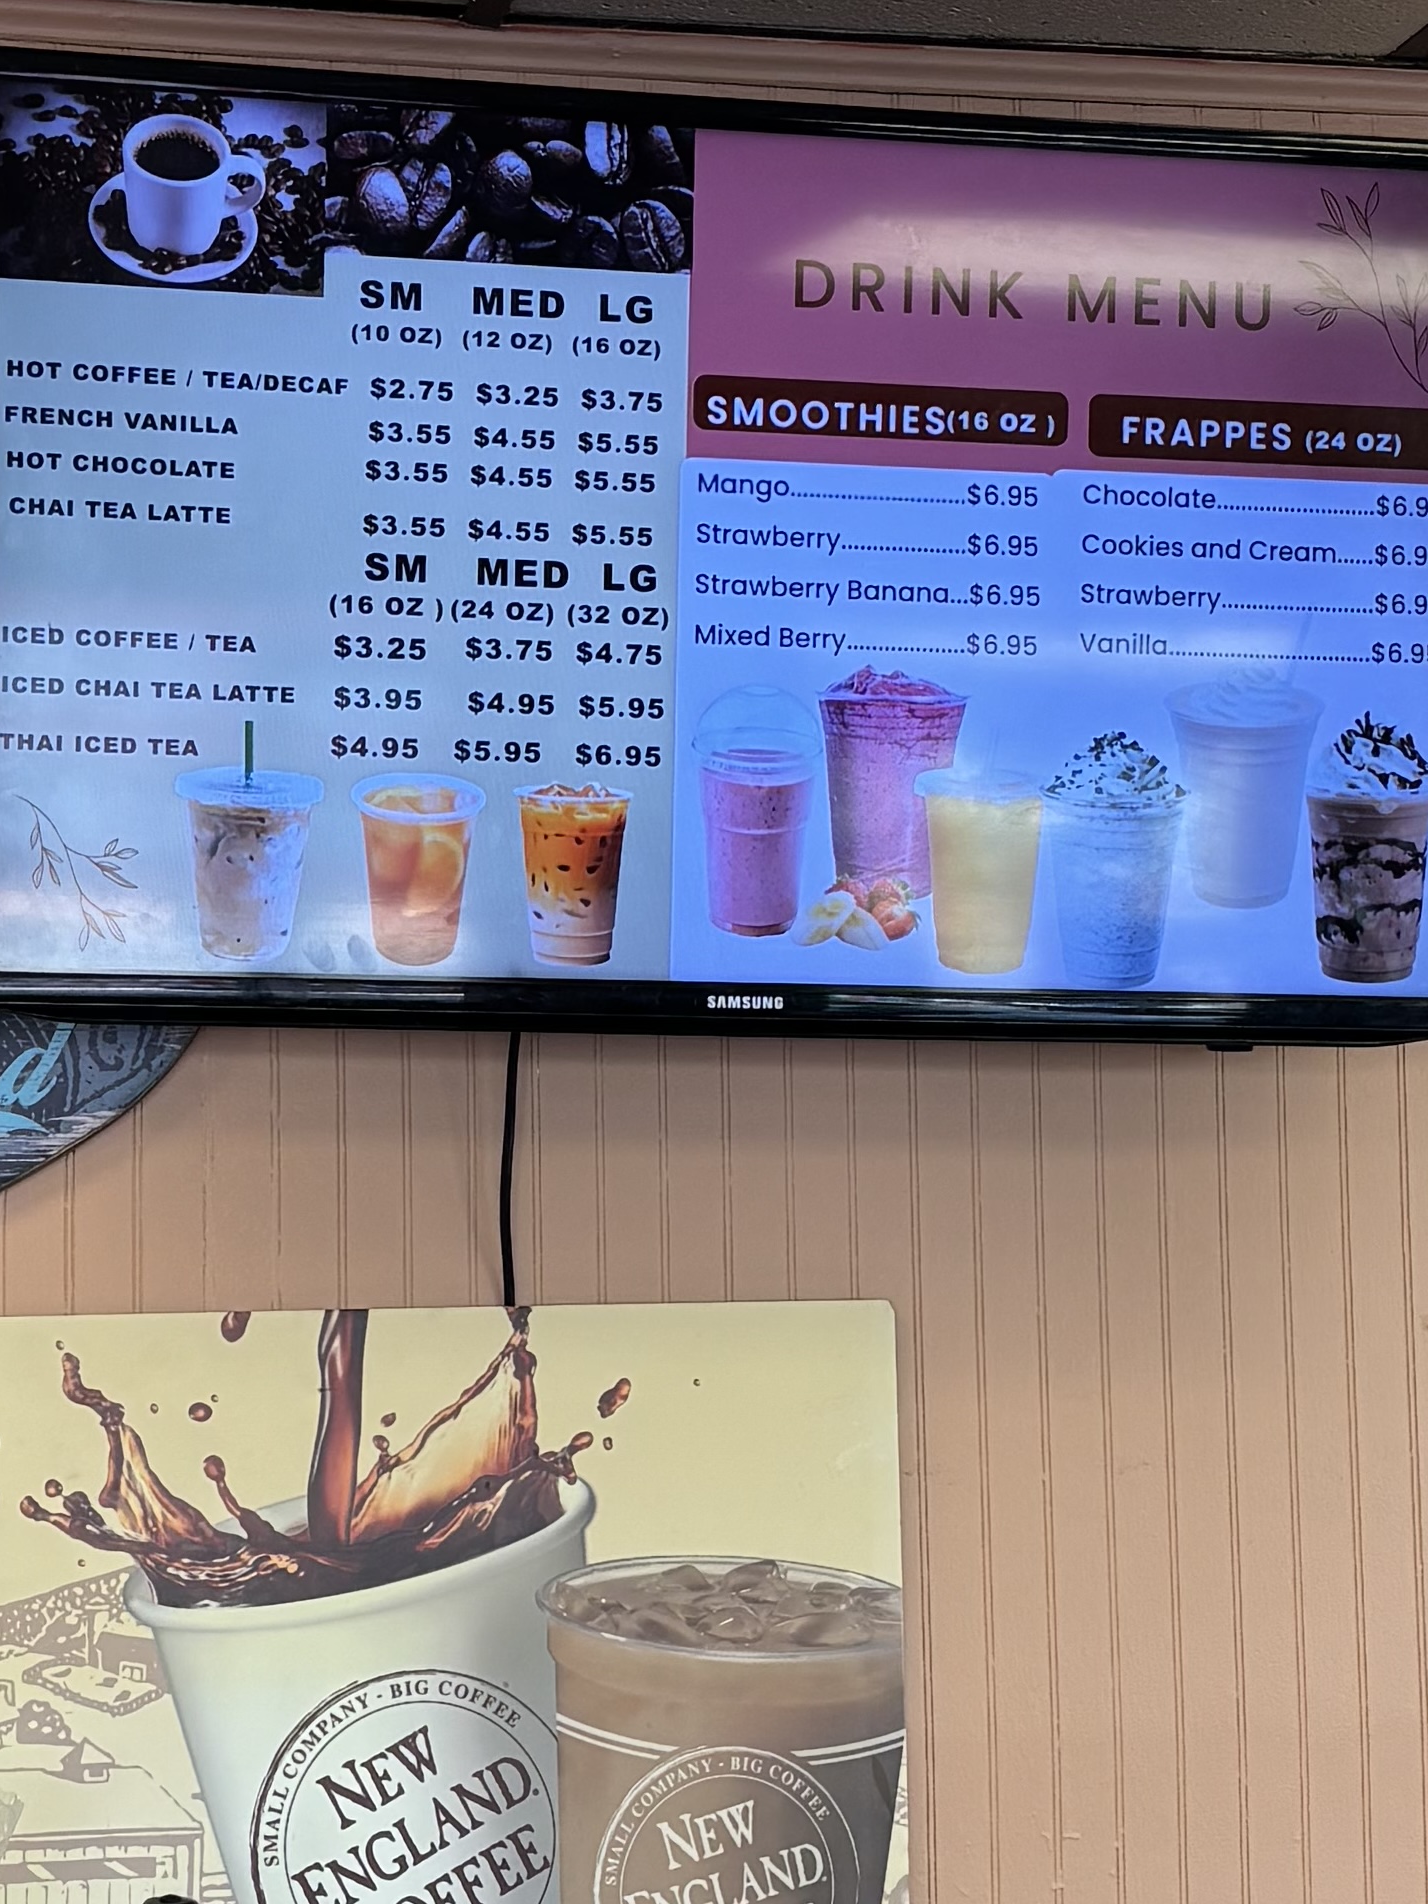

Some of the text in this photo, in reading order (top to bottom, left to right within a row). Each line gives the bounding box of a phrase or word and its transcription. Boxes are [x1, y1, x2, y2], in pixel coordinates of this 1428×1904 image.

[359, 281, 654, 324] SM MED LG
[794, 258, 1274, 331] DRINK MENU
[350, 323, 662, 361] (10 OZ) (12 OZ) (16 OZ)
[7, 360, 62, 381] HOT
[73, 362, 176, 385] COFFEE
[371, 377, 663, 414] $2.75 $3.25 $3.75
[4, 406, 238, 436] FRENCH VANILLA
[1122, 416, 1403, 456] FRAPPES (24 OZ)
[369, 421, 659, 456] $3.55 $4.55 $5.55
[7, 451, 236, 479] HOT CHOCOLATE
[365, 459, 656, 494] $3.55 $4.55 $5.55
[9, 497, 231, 526] CHAI TEA LATTE
[363, 514, 653, 548] $3.55 $4.55 $5.55
[1081, 534, 1184, 559] Cookies
[1191, 538, 1241, 561] and
[364, 553, 657, 593] SM MED LG
[695, 573, 840, 605] Strawberry
[330, 593, 374, 617] (16
[450, 598, 554, 626] (24 OZ)
[567, 604, 669, 630] (32 OZ)
[1, 624, 256, 654] ICED COFFEE TEA
[334, 635, 662, 666] $3.25 $3.75 $4.75
[695, 623, 770, 648] Mixed
[1, 676, 295, 705] ICED CHAI TEA LATTE
[334, 687, 664, 720] $3.95 $4.95 $5.95
[0, 733, 198, 757] THAI ICED TEA
[331, 735, 662, 768] $4.95 $5.95 $6.95
[707, 995, 783, 1011] SAMSUNG
[263, 1678, 521, 1868] SMALL COMPANY BIG COFFEE
[316, 1725, 439, 1830] NEW
[657, 1800, 755, 1871] NEW
